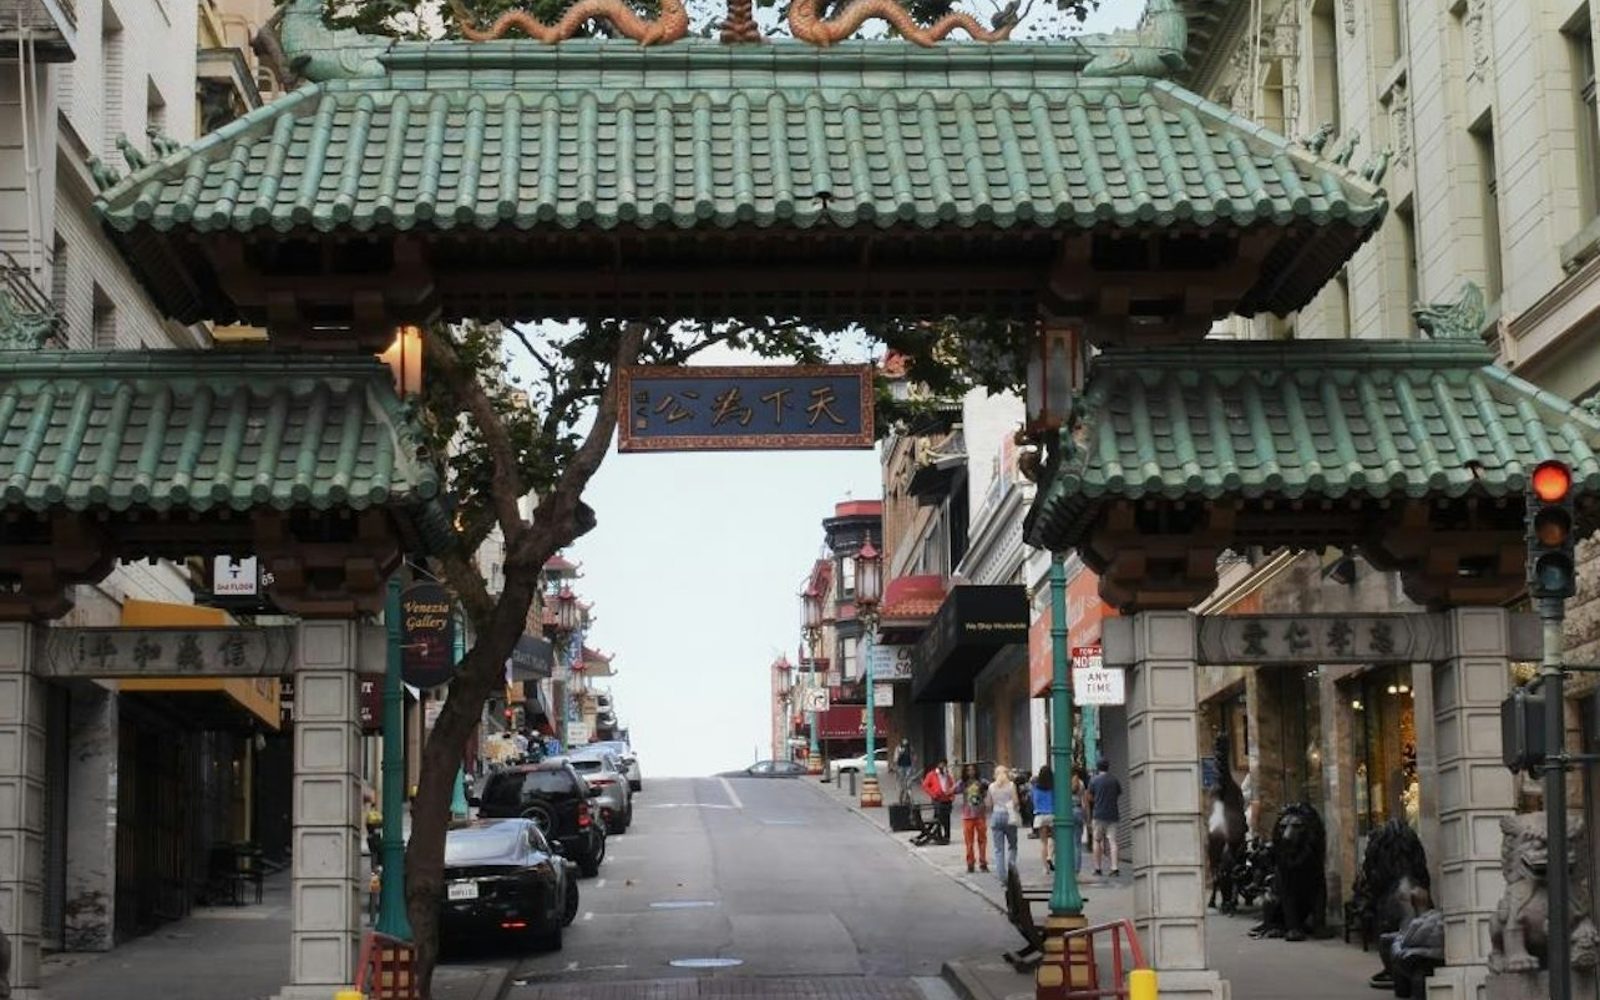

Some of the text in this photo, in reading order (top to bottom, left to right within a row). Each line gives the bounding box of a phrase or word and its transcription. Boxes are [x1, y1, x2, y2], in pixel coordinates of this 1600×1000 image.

[404, 600, 450, 613] Venezia
[406, 614, 448, 632] Gallery
[1087, 673, 1110, 682] ANY
[1087, 683, 1112, 694] TIME
